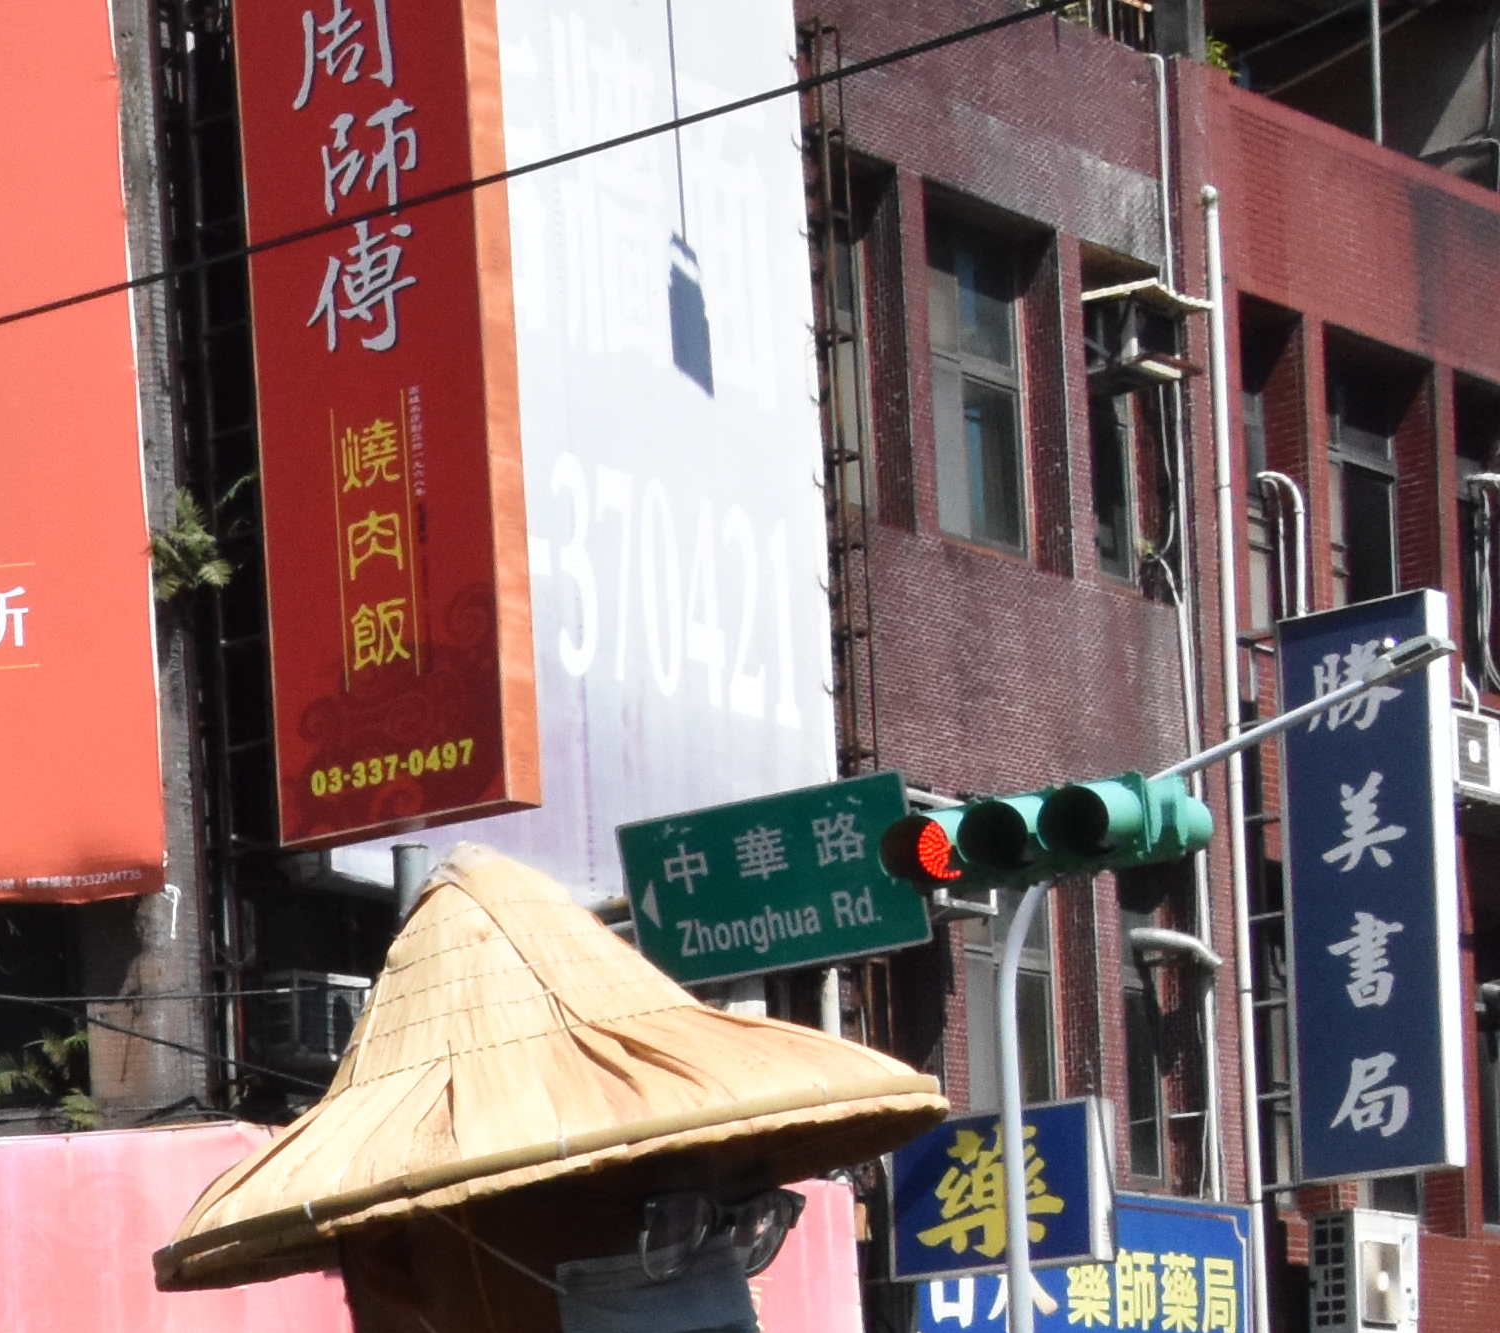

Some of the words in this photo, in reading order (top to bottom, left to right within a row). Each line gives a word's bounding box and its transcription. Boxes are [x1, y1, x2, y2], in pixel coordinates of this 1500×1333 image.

[293, 0, 420, 353] 周師傅
[341, 417, 409, 671] 燒肉飯
[311, 738, 475, 796] 03-337-0497
[664, 812, 866, 896] 中華路
[1308, 645, 1408, 1140] 勝美書局
[677, 905, 821, 959] Zhonghua
[832, 890, 882, 931] Rd.
[917, 1125, 1066, 1261] 藥
